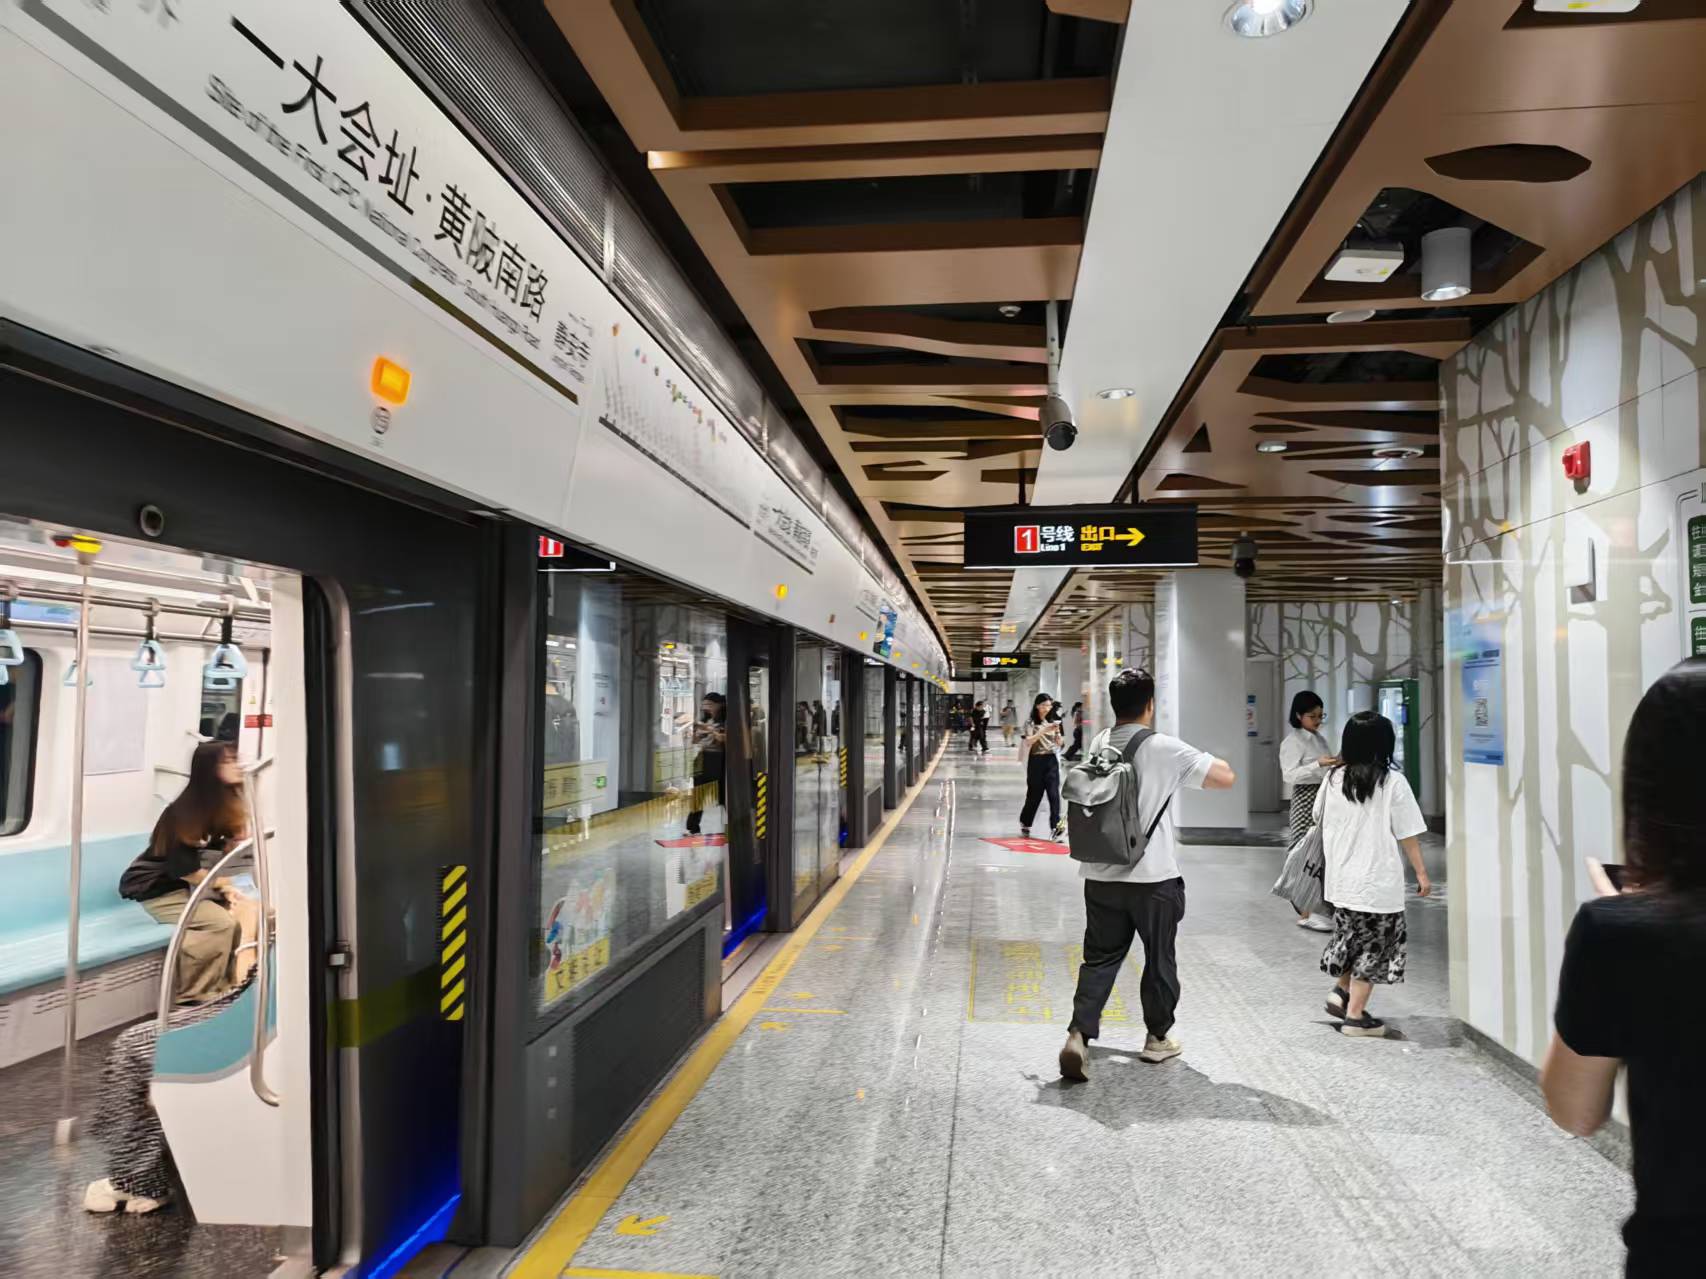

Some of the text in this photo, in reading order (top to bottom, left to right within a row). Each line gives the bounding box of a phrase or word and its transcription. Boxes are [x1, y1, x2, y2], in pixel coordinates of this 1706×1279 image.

[1021, 528, 1034, 551] 1
[1040, 525, 1075, 543] 号线
[1080, 524, 1116, 542] 出口
